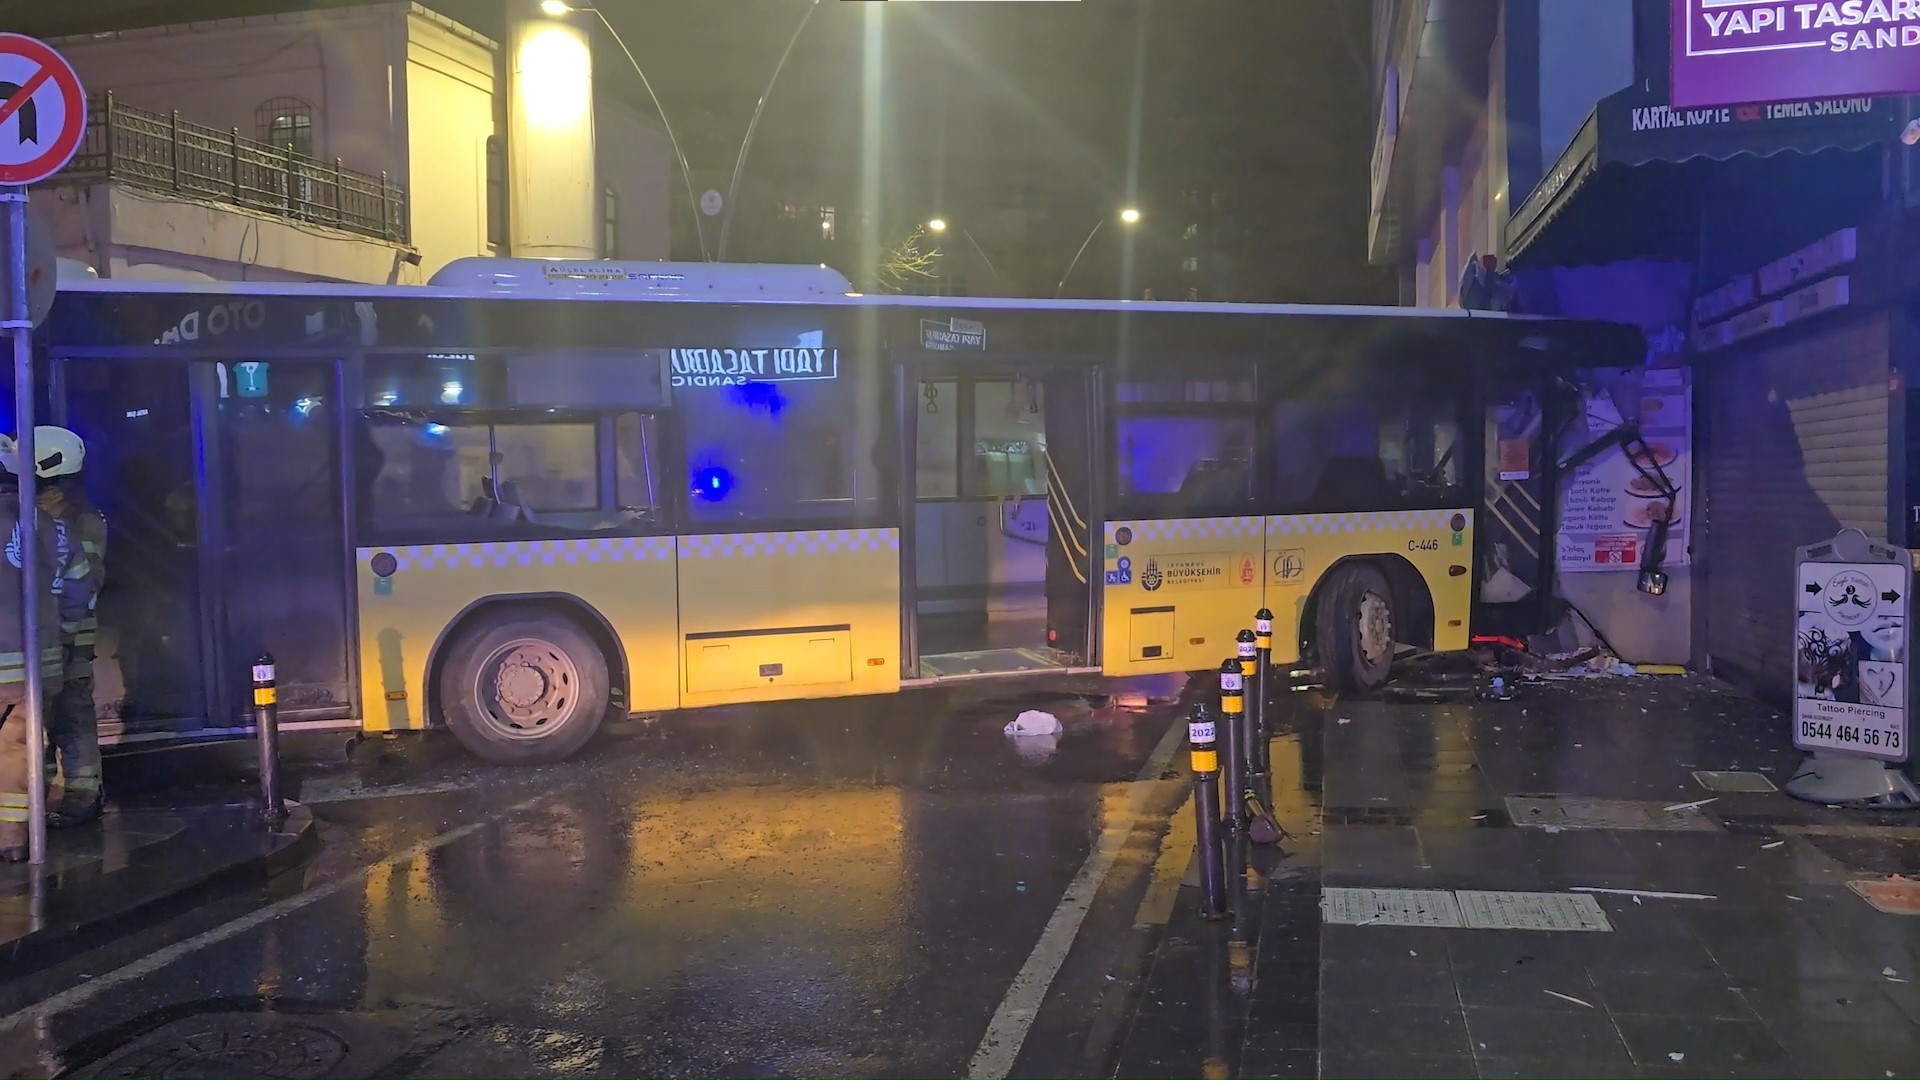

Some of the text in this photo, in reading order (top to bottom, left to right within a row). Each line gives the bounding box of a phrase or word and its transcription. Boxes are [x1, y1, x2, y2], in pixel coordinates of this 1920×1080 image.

[1702, 6, 1785, 37] YAPI
[1407, 538, 1439, 551] C-446
[1166, 566, 1221, 578] BÜYÜKŞEHİR
[1816, 703, 1845, 713] Tattoo
[1847, 706, 1886, 720] Piercing
[1191, 727, 1215, 738] 2022
[1801, 721, 1900, 748] 0544 464 56 73
